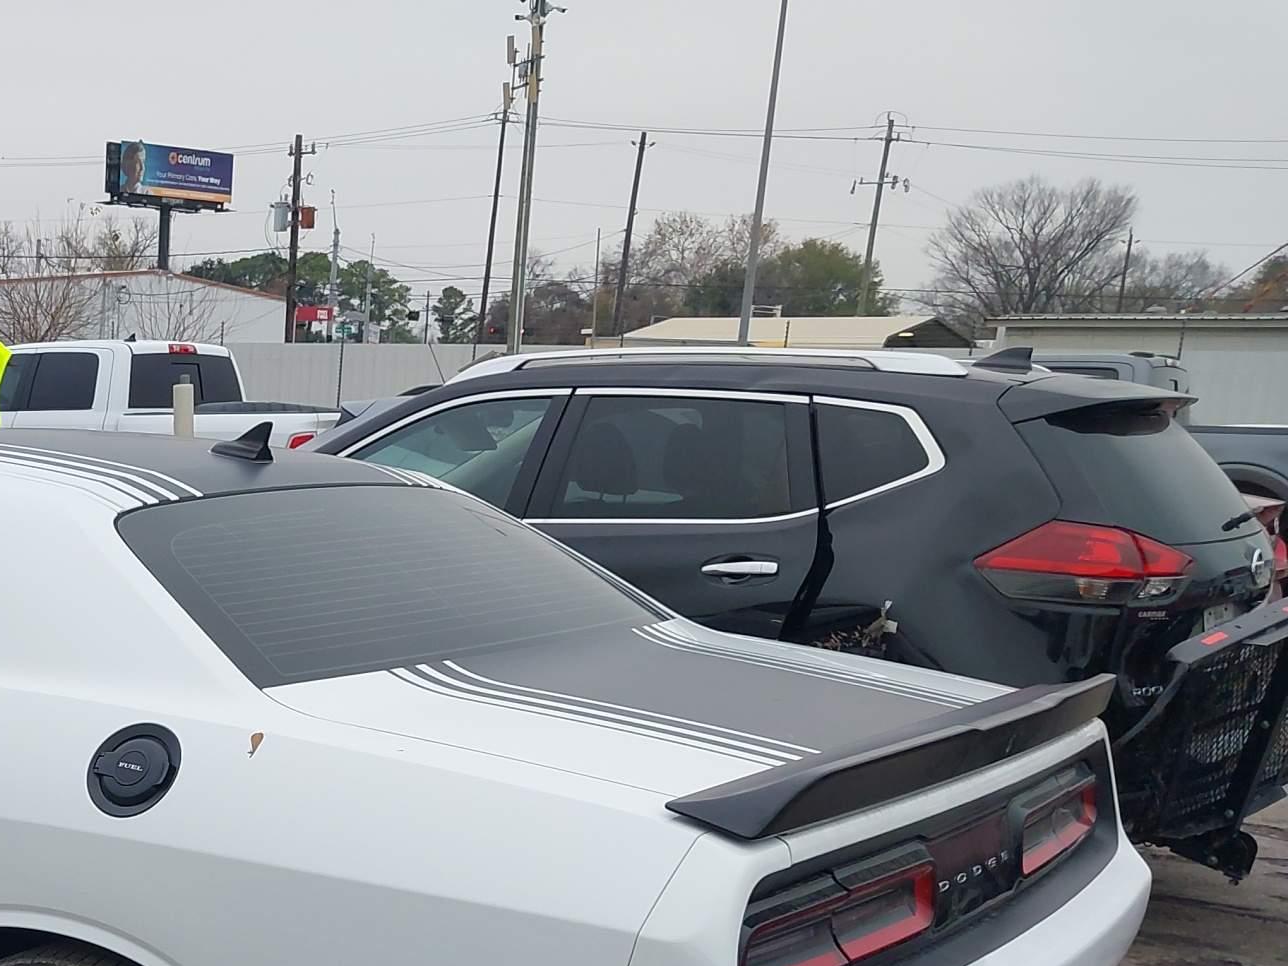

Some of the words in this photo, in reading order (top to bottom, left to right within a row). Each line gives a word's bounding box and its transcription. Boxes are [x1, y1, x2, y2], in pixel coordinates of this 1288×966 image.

[177, 153, 211, 167] centrum
[118, 761, 143, 772] FUEL
[938, 850, 1009, 892] DODGE
